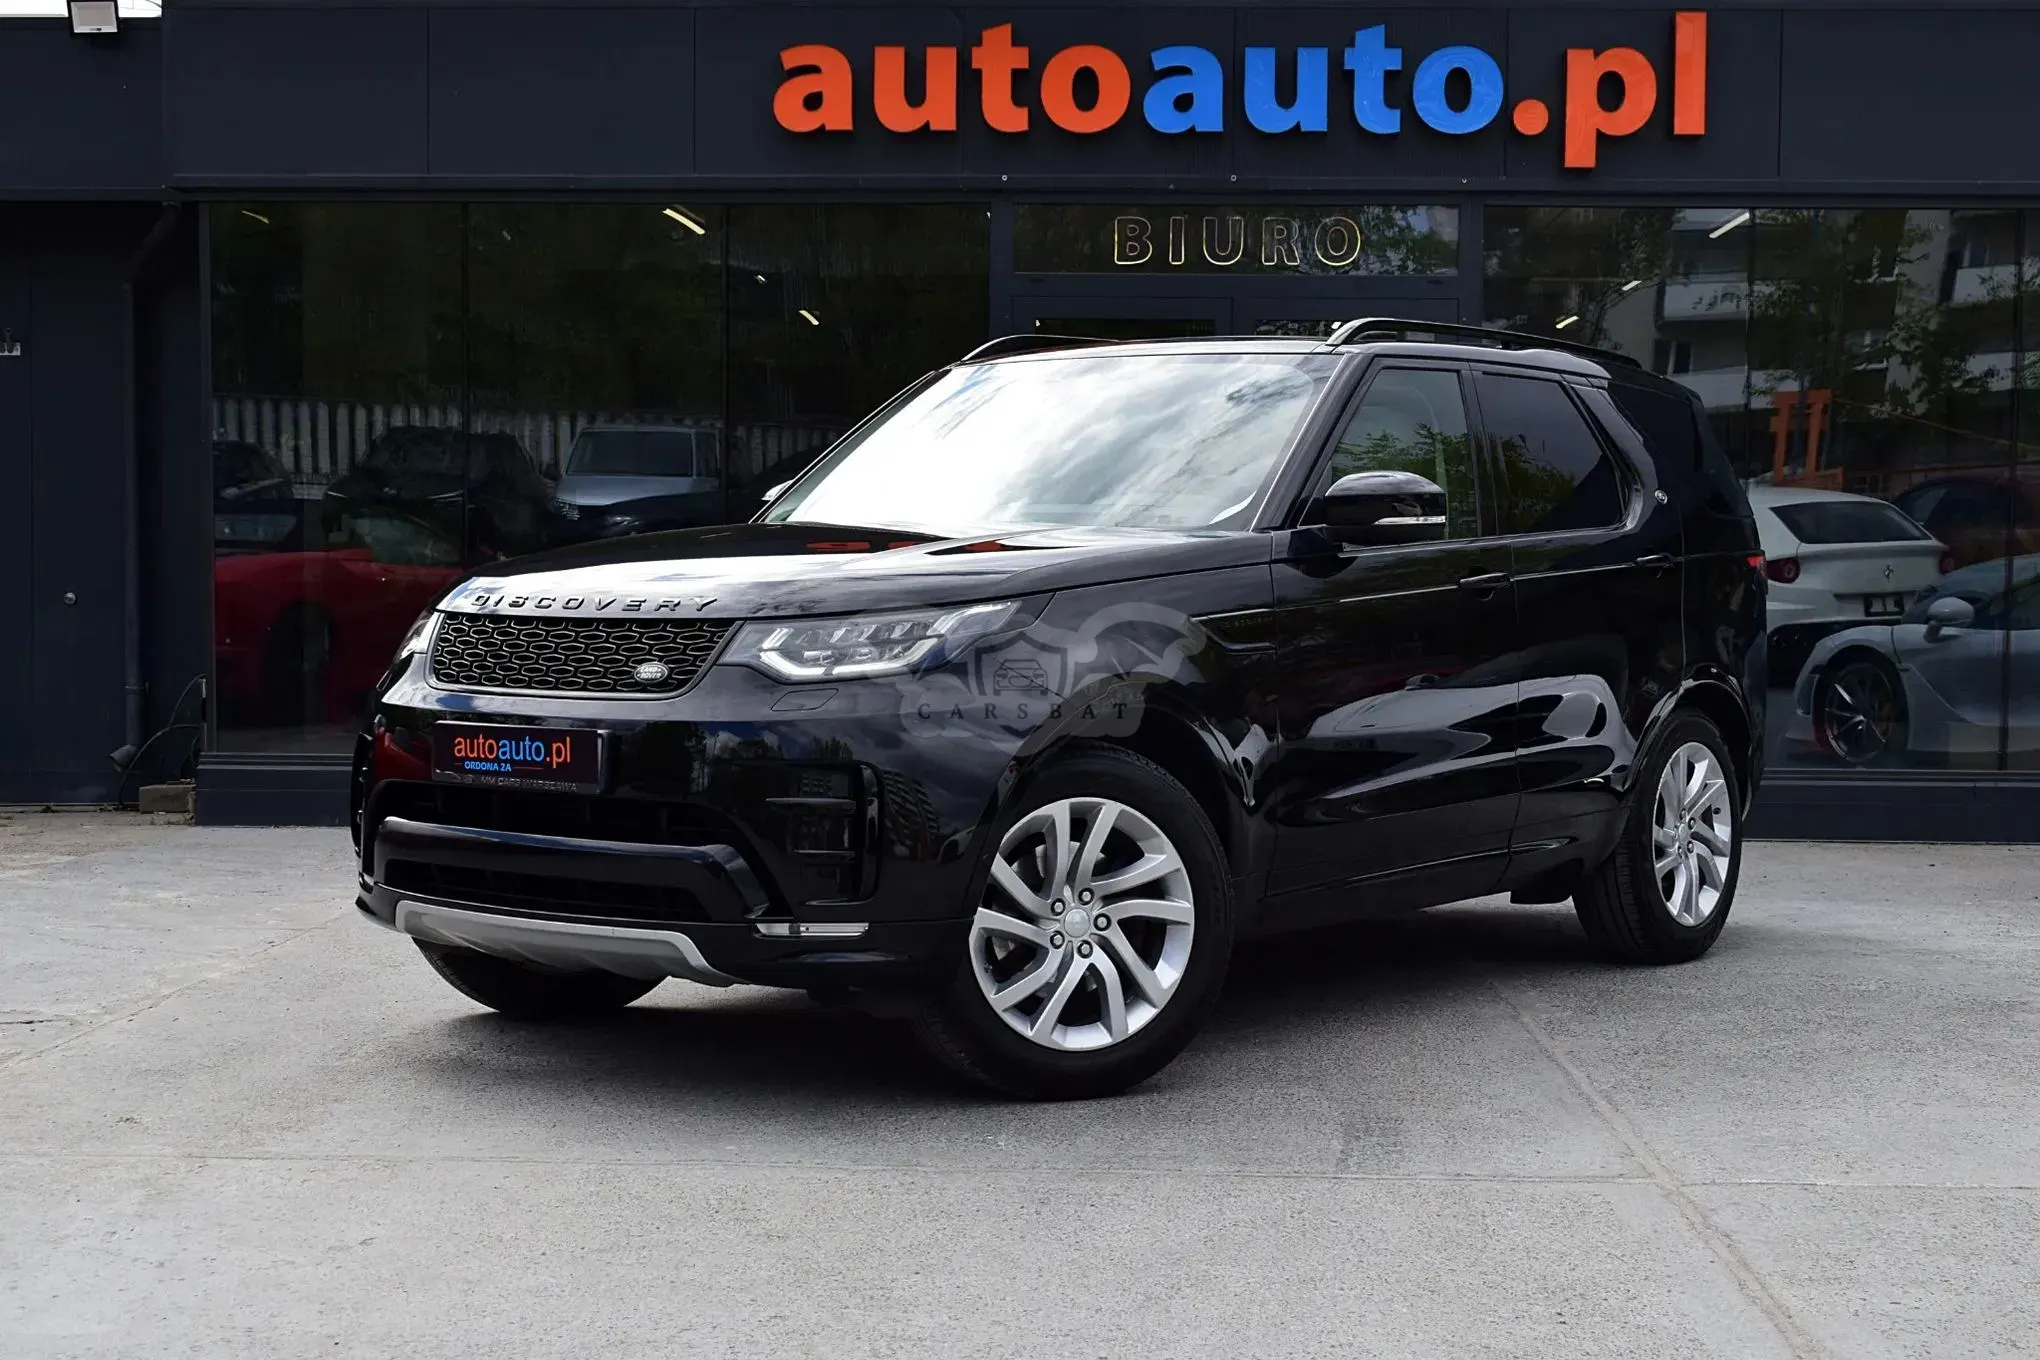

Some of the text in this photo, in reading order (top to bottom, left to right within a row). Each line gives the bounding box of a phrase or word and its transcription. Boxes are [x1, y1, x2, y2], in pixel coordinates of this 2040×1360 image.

[773, 11, 1707, 169] autoauto.pl
[1113, 216, 1362, 266] BIURO
[470, 594, 719, 613] DISCOVERY
[453, 733, 571, 769] autoauto.pl
[464, 761, 499, 771] ORDONA
